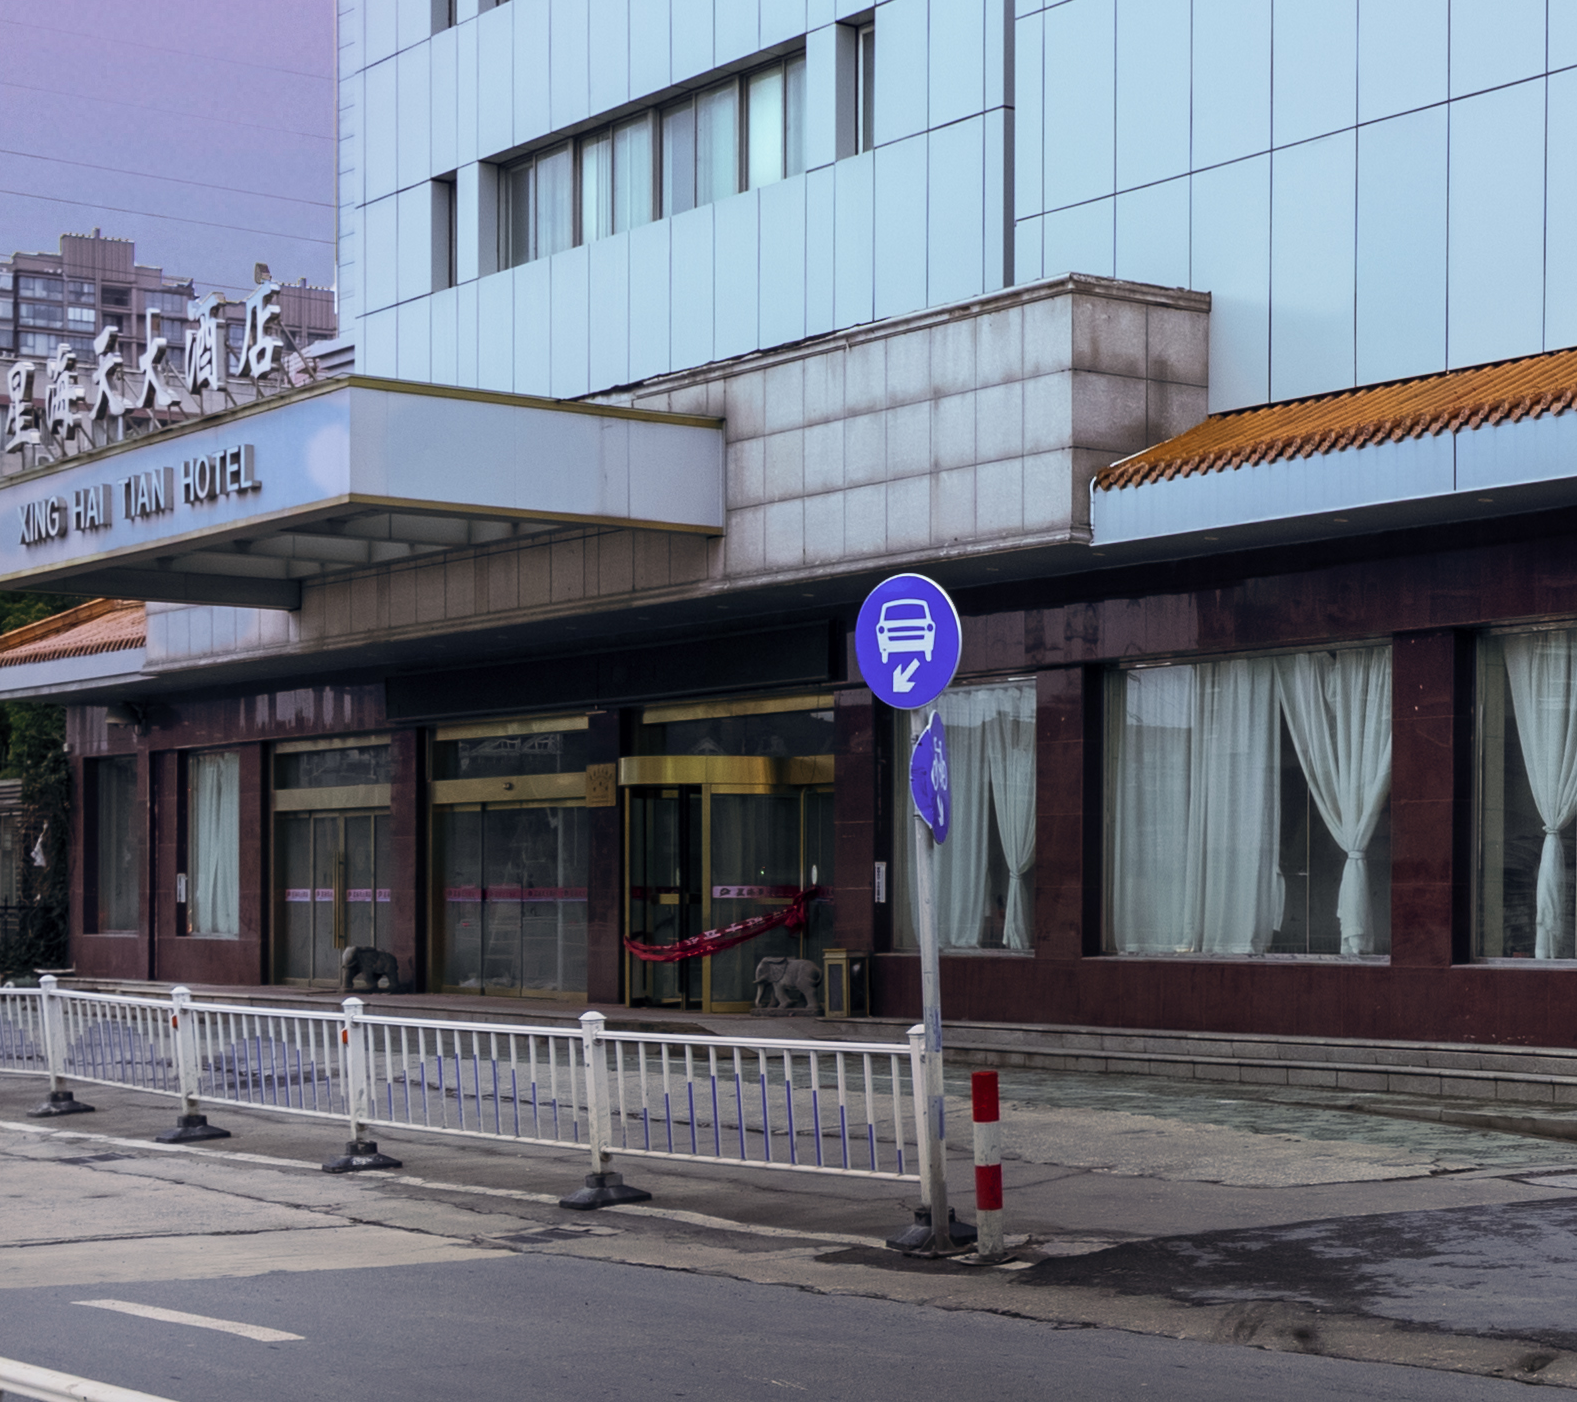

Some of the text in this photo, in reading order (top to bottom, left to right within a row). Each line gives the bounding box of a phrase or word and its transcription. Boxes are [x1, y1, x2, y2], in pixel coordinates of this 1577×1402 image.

[6, 280, 283, 454] 星海天大酒店
[17, 444, 261, 546] XING HAI TIAN HOTEL
